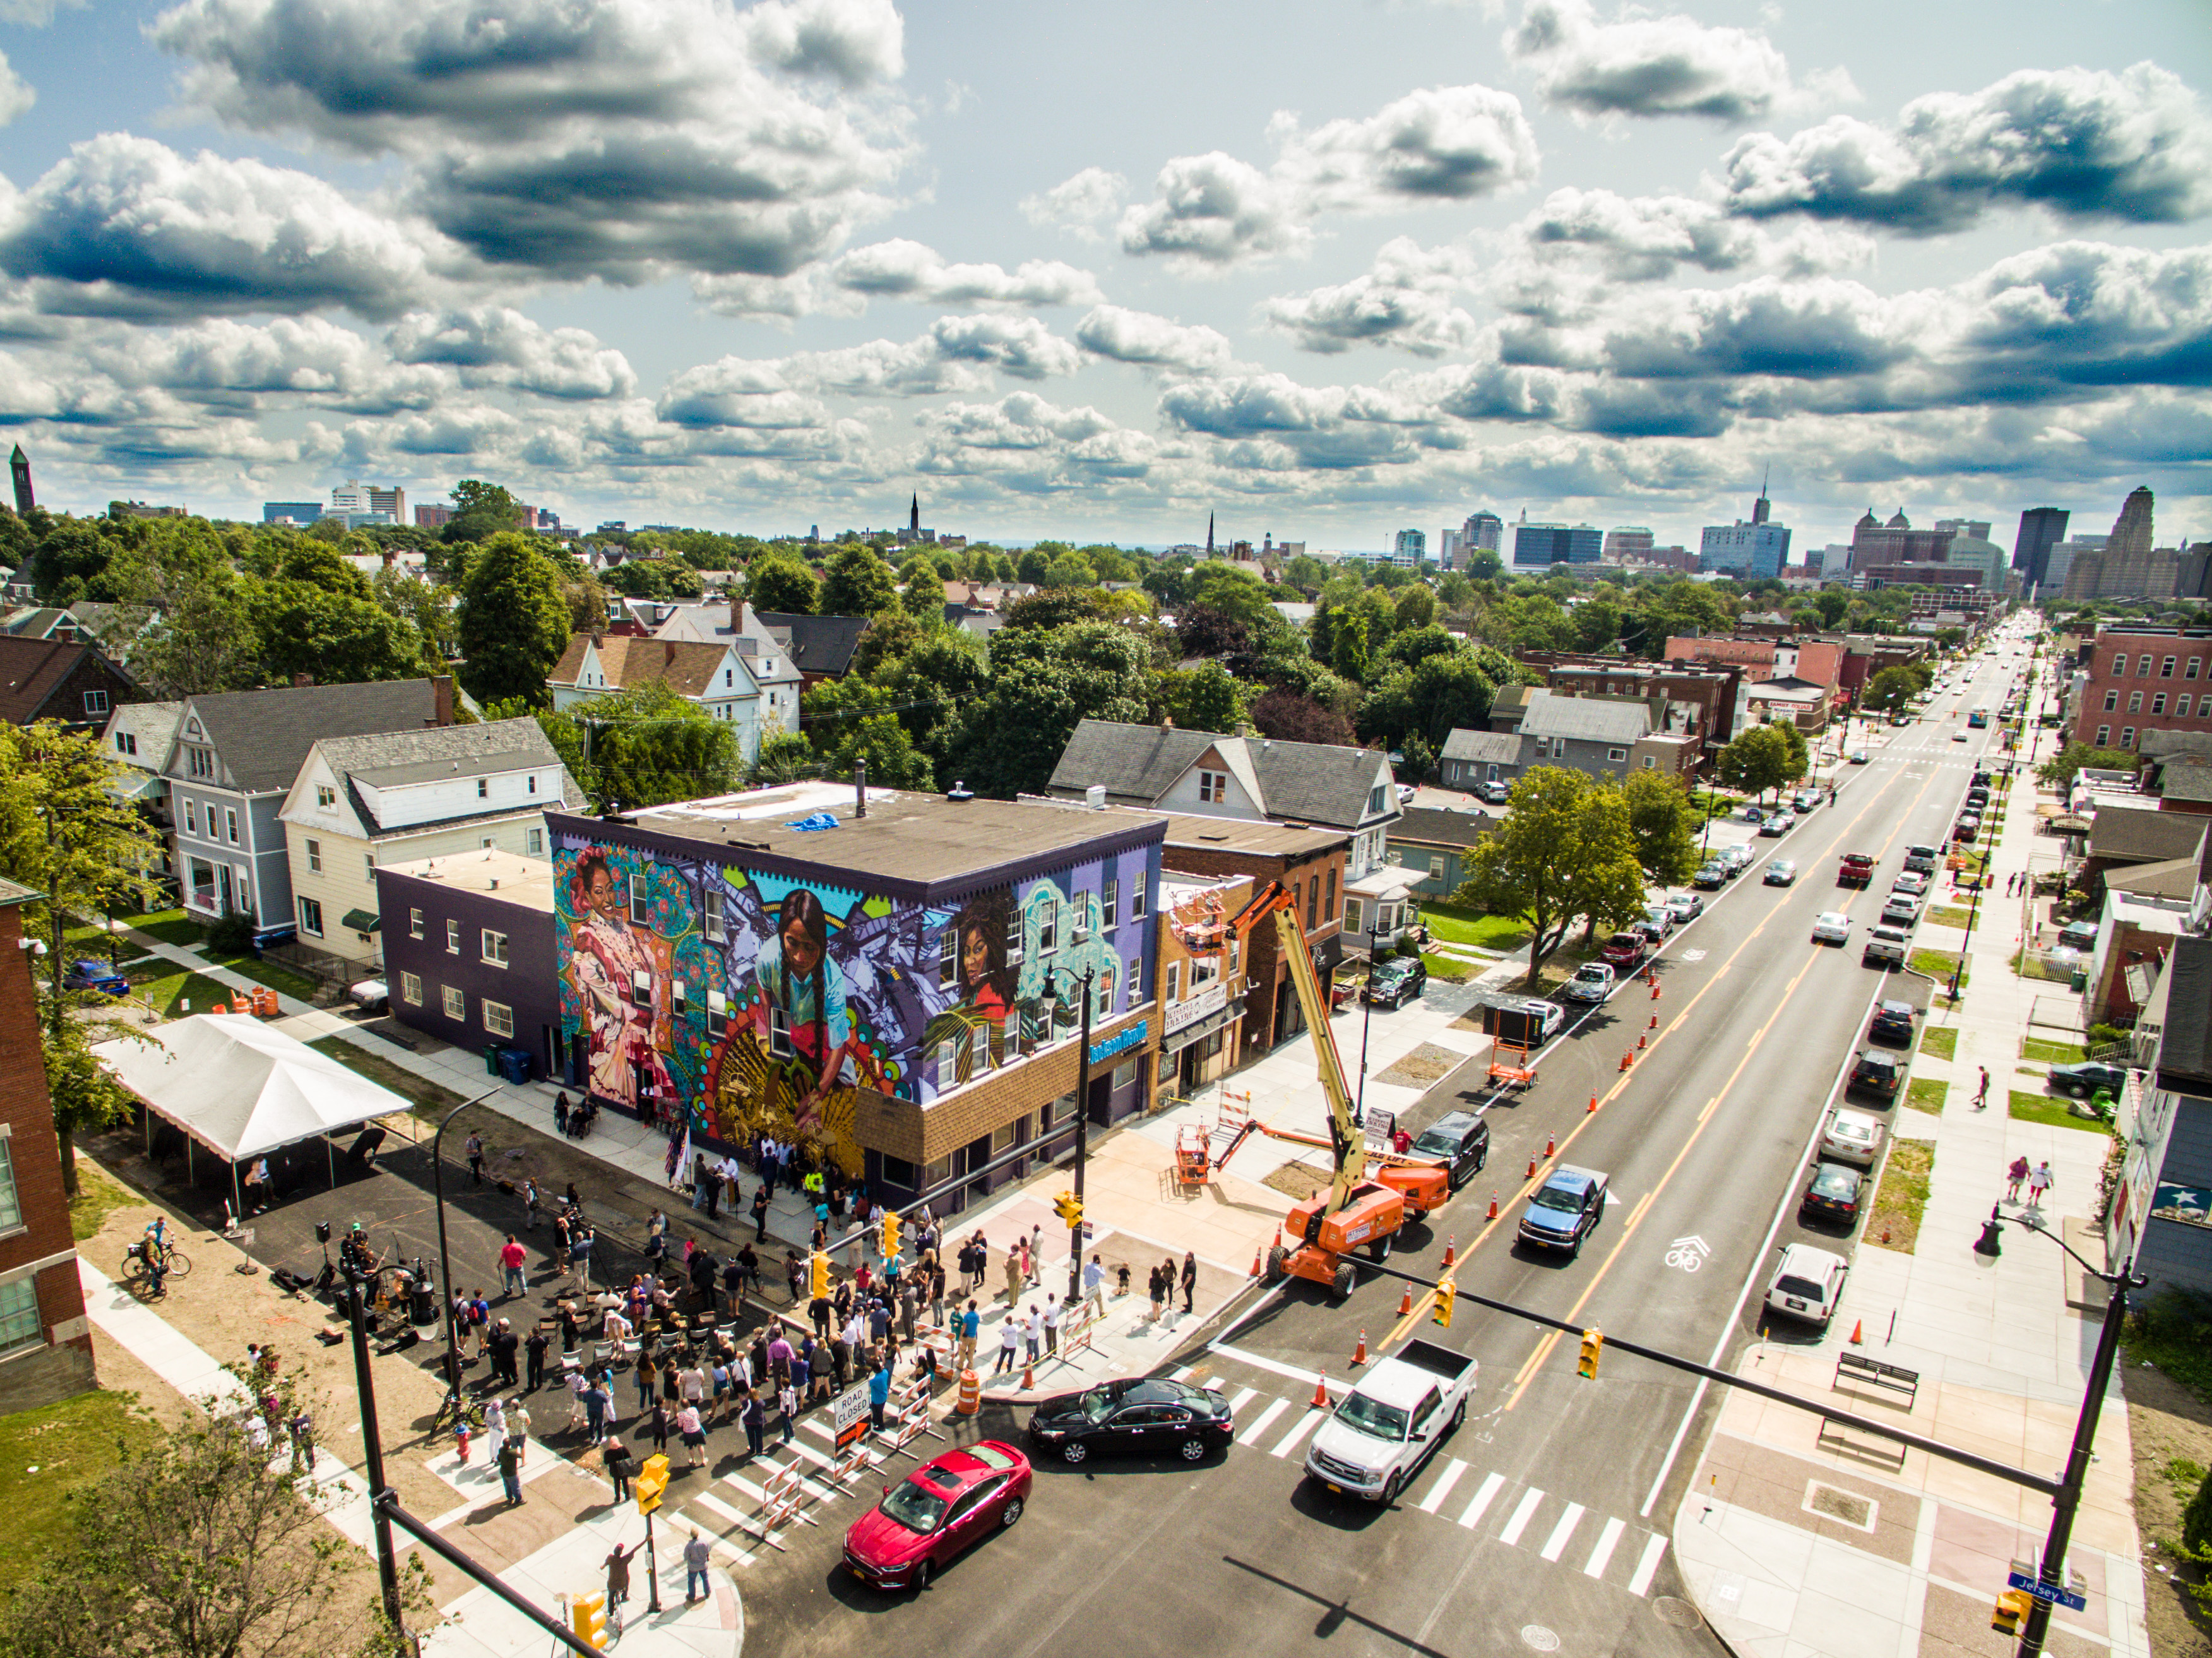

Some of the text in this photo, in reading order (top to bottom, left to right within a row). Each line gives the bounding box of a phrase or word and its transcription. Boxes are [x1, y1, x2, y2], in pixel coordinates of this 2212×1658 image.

[2074, 814, 2091, 824] FAMILY
[1167, 1002, 1193, 1020] WISHFUL
[1167, 1010, 1193, 1030] INKING
[1089, 1036, 1122, 1065] Jackson
[1121, 1019, 1147, 1049] Hewitt
[1386, 1155, 1407, 1164] LIFT
[842, 1390, 862, 1410] ROAD
[838, 1399, 867, 1424] CLOSED
[838, 1428, 857, 1446] DETOUR
[2019, 1579, 2075, 1605] Jersey St
